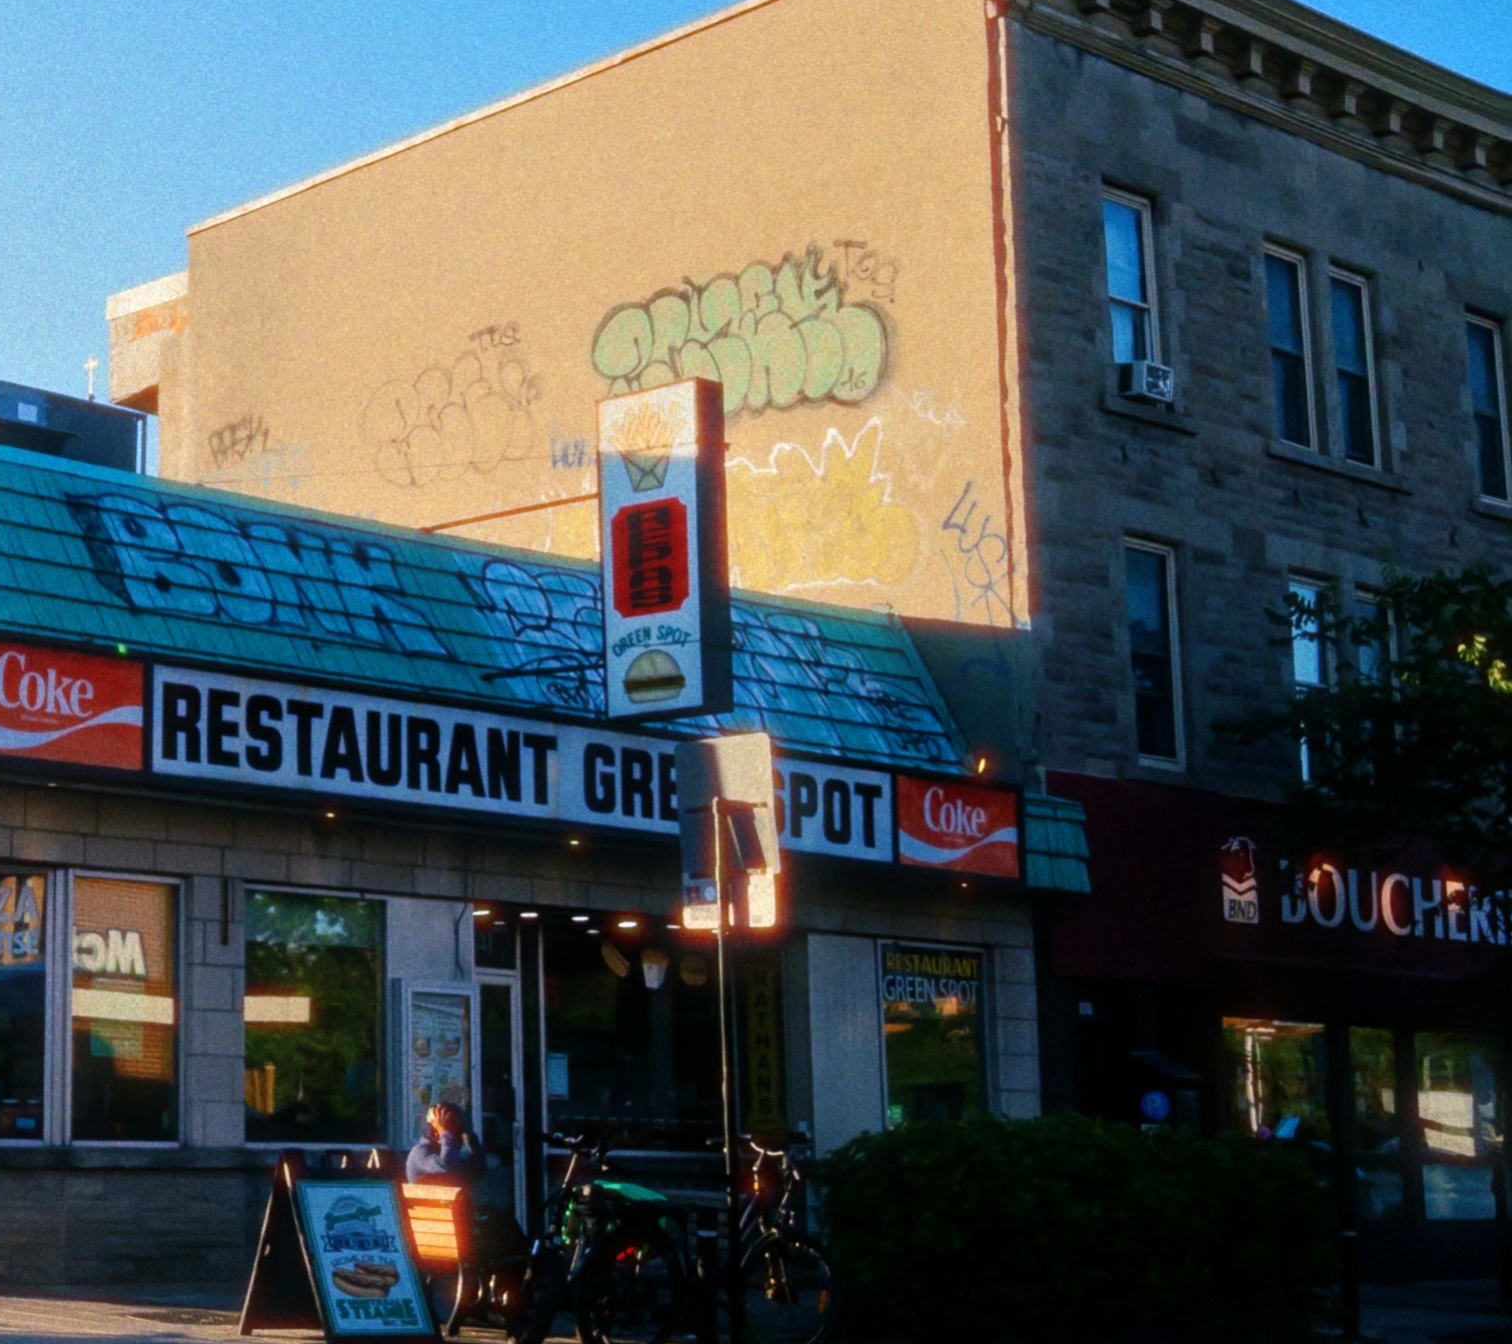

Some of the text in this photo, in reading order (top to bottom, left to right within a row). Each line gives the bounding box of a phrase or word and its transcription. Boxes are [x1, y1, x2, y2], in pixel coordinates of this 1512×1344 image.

[613, 623, 692, 657] GREEN SPOT
[162, 681, 558, 806] RESTAURANT
[582, 742, 678, 822] GRE
[923, 785, 987, 838] Coke
[1227, 899, 1257, 920] BND
[886, 952, 979, 979] RESTAURANT
[882, 975, 979, 1006] GREEN SPOT
